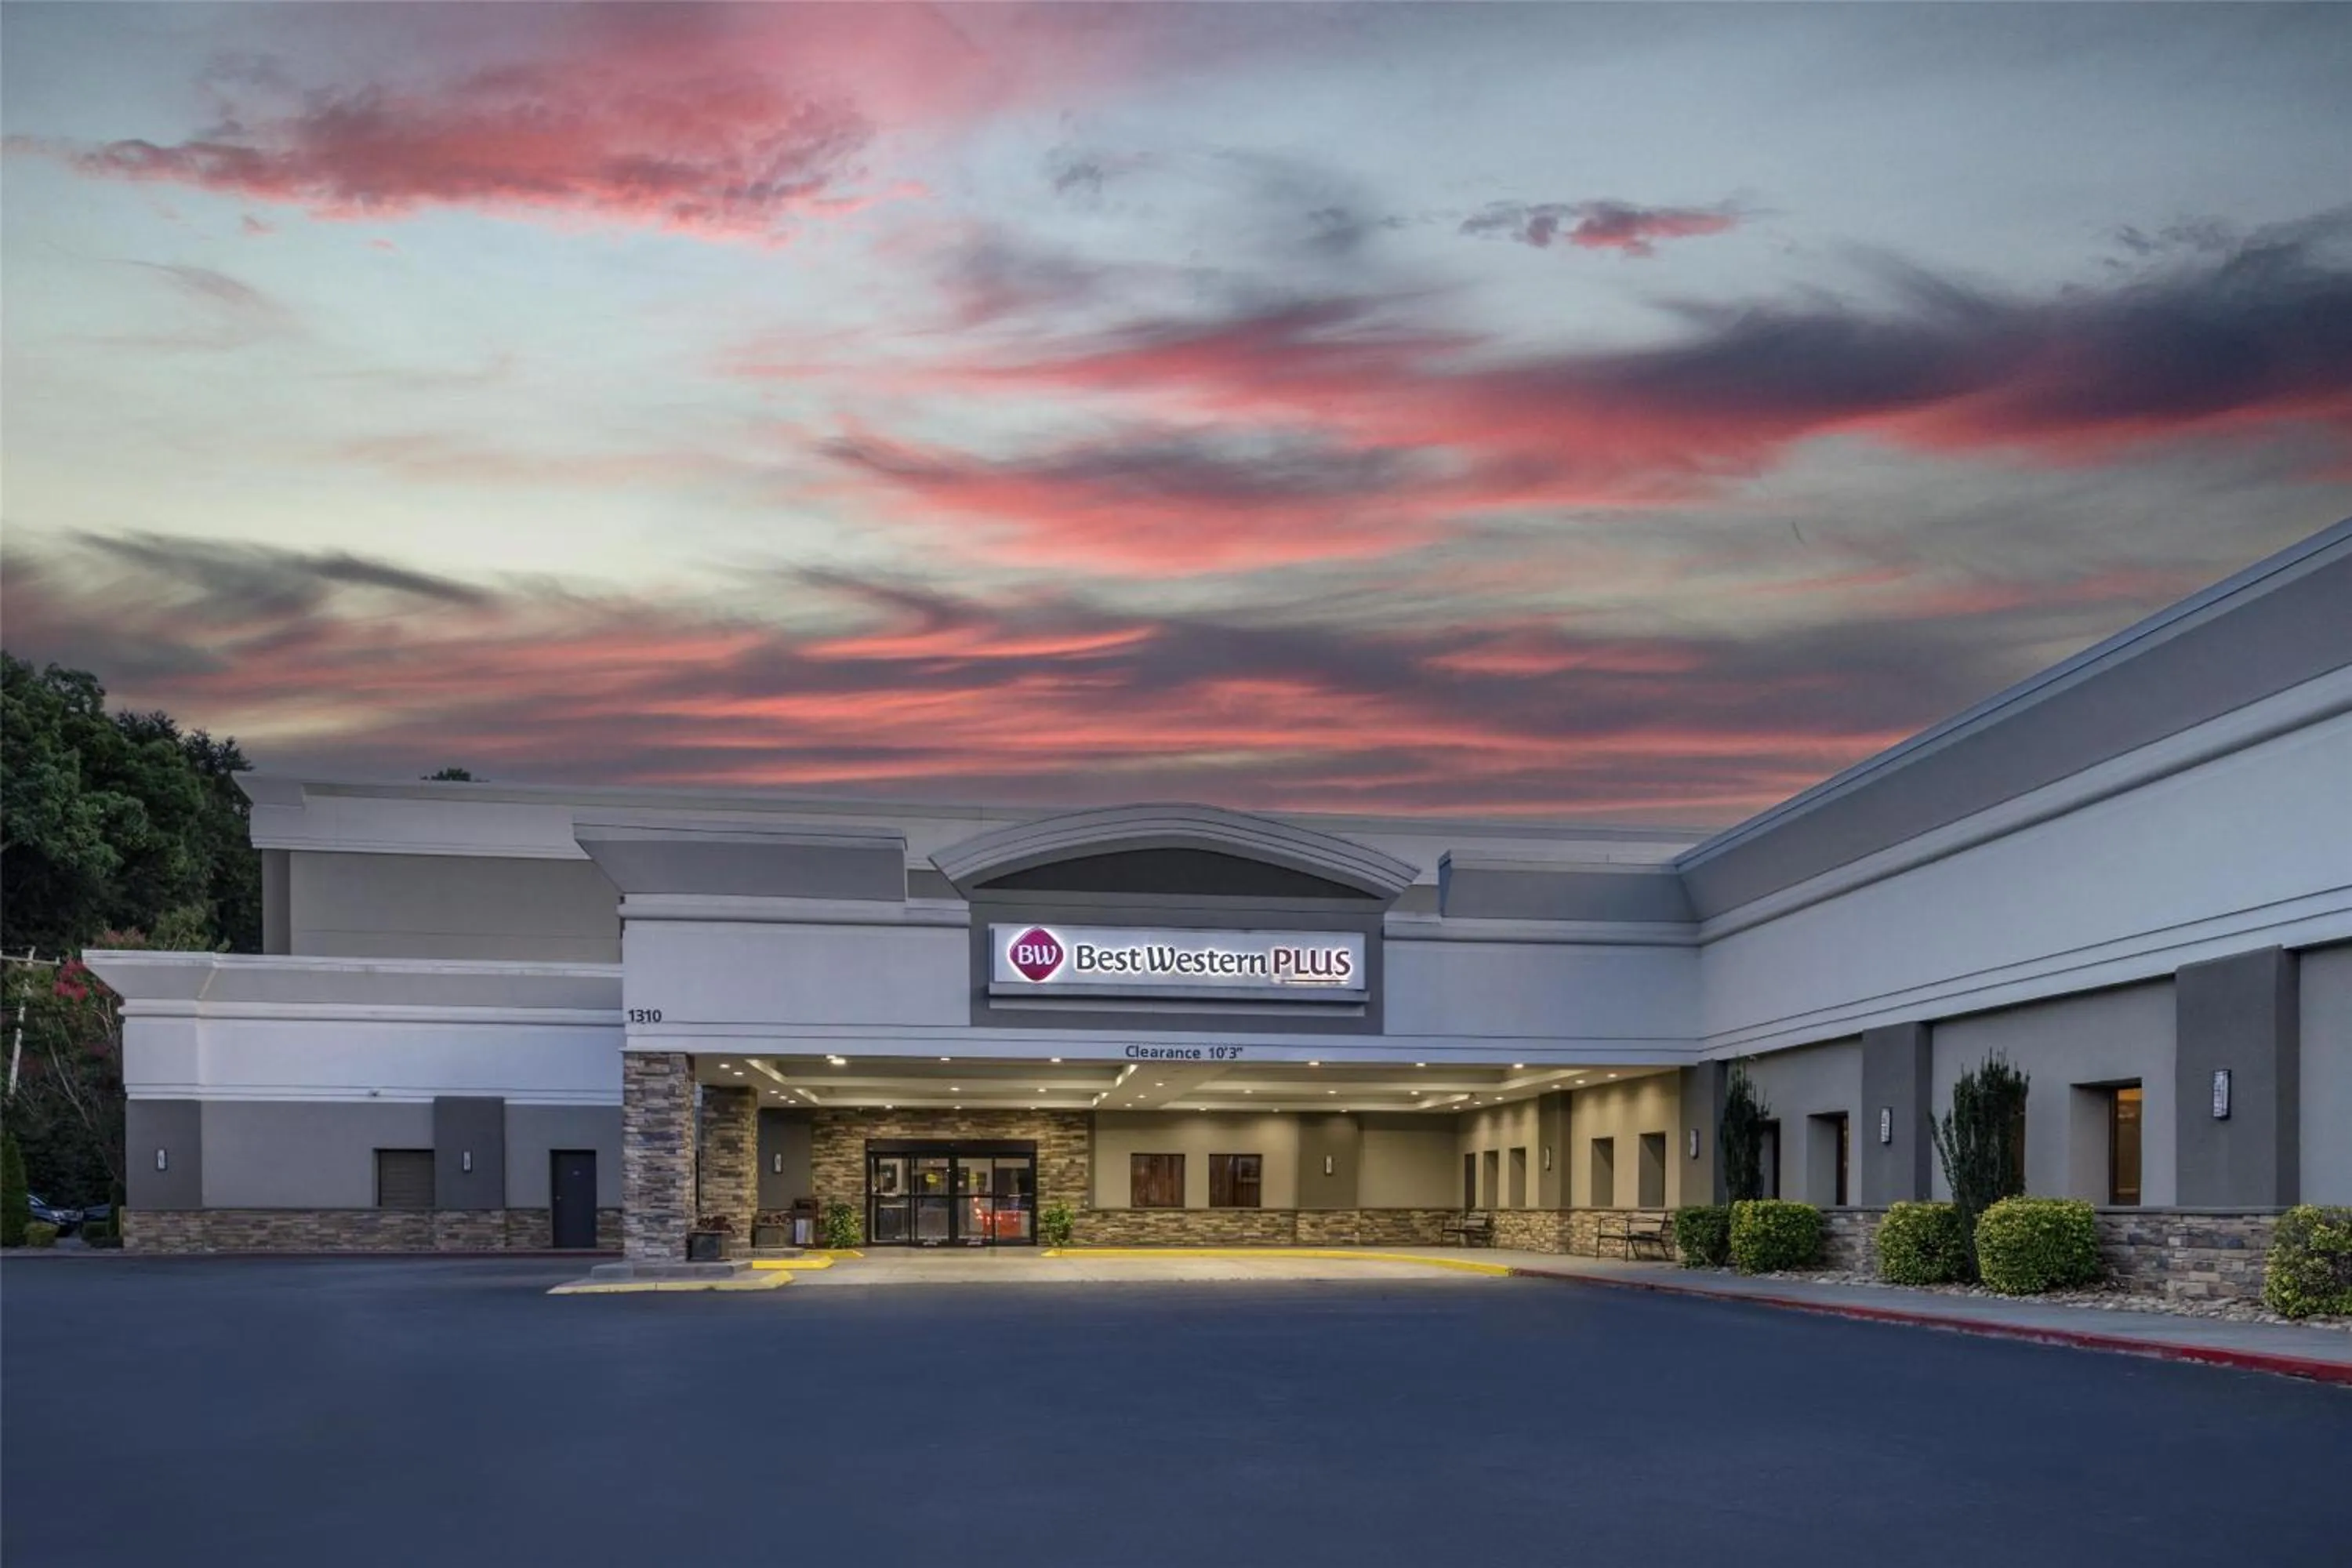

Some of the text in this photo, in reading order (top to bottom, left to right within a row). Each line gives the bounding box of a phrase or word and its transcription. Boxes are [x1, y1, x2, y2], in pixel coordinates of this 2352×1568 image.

[1018, 944, 1058, 965] BW
[1076, 945, 1351, 977] Best Western PLUS
[628, 1009, 662, 1023] 1310
[1125, 1045, 1201, 1058] Clearance
